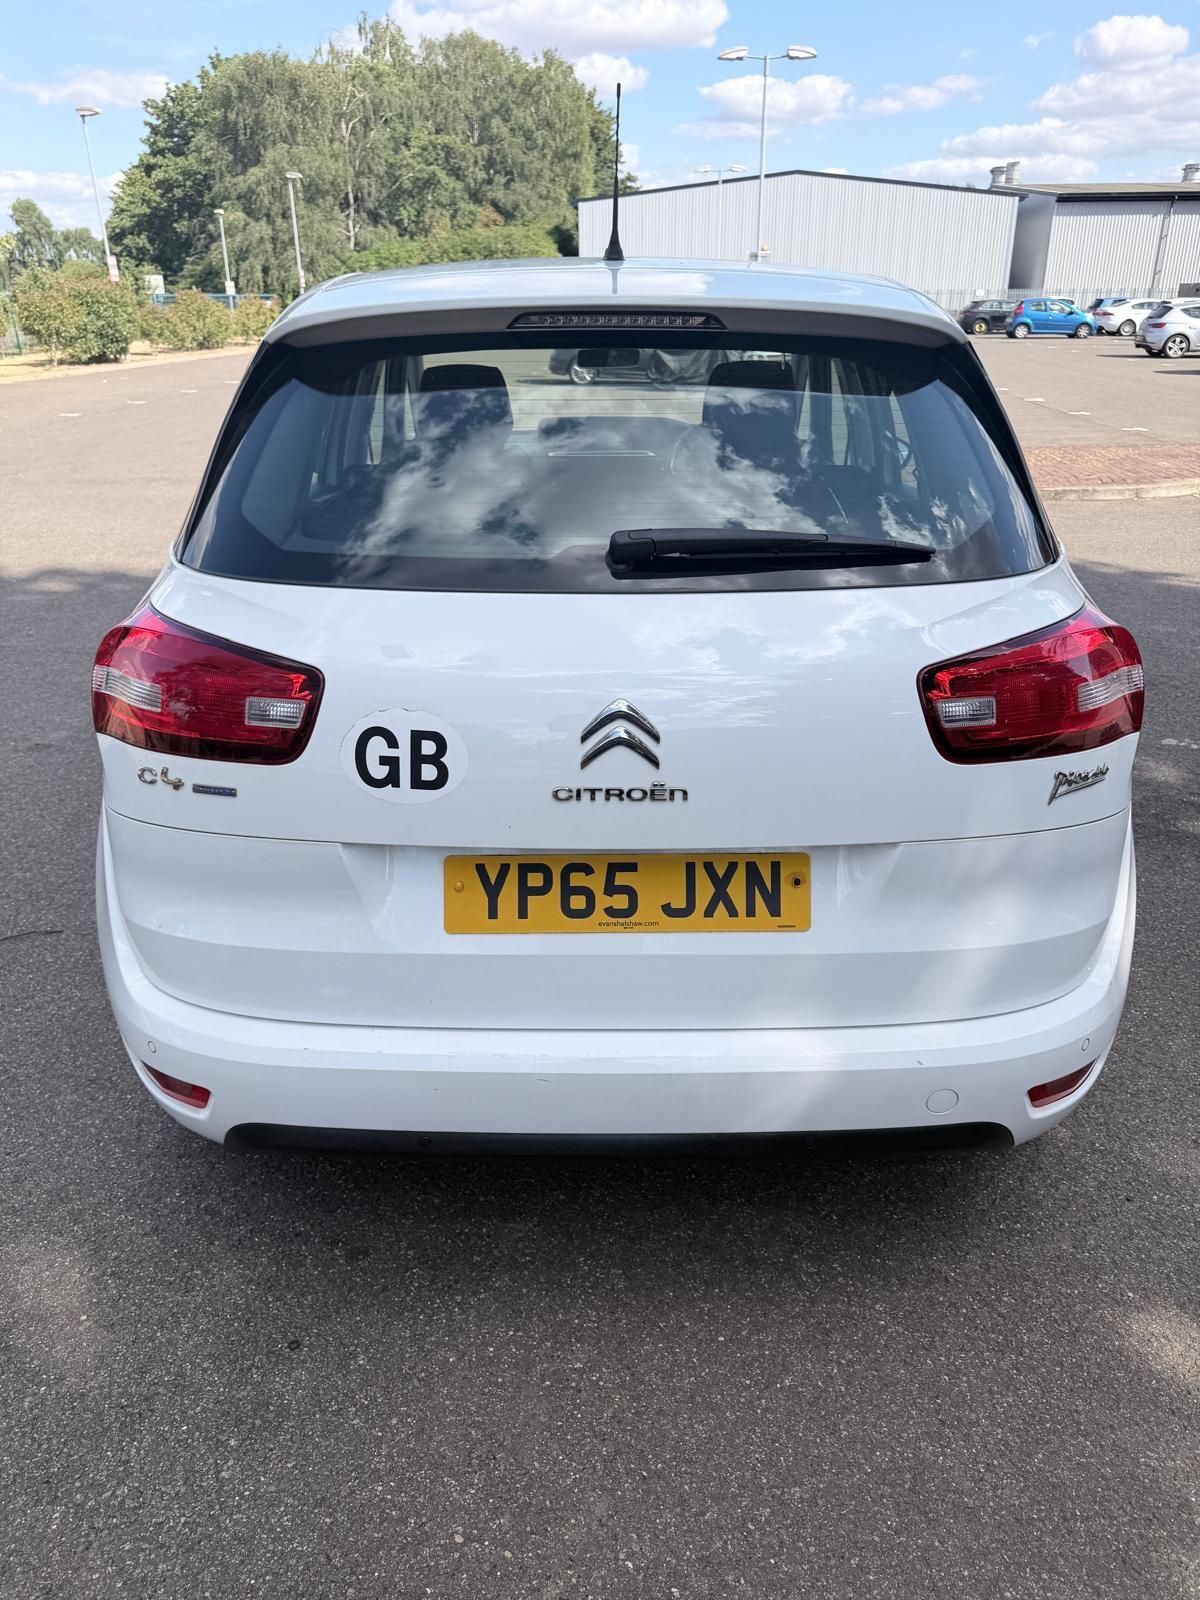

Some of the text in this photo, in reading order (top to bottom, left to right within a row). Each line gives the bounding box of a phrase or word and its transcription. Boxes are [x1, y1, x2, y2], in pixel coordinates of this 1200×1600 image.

[137, 766, 184, 791] C4
[355, 726, 450, 791] GB
[552, 781, 689, 802] CITROËN
[475, 861, 782, 919] YP65 JXN
